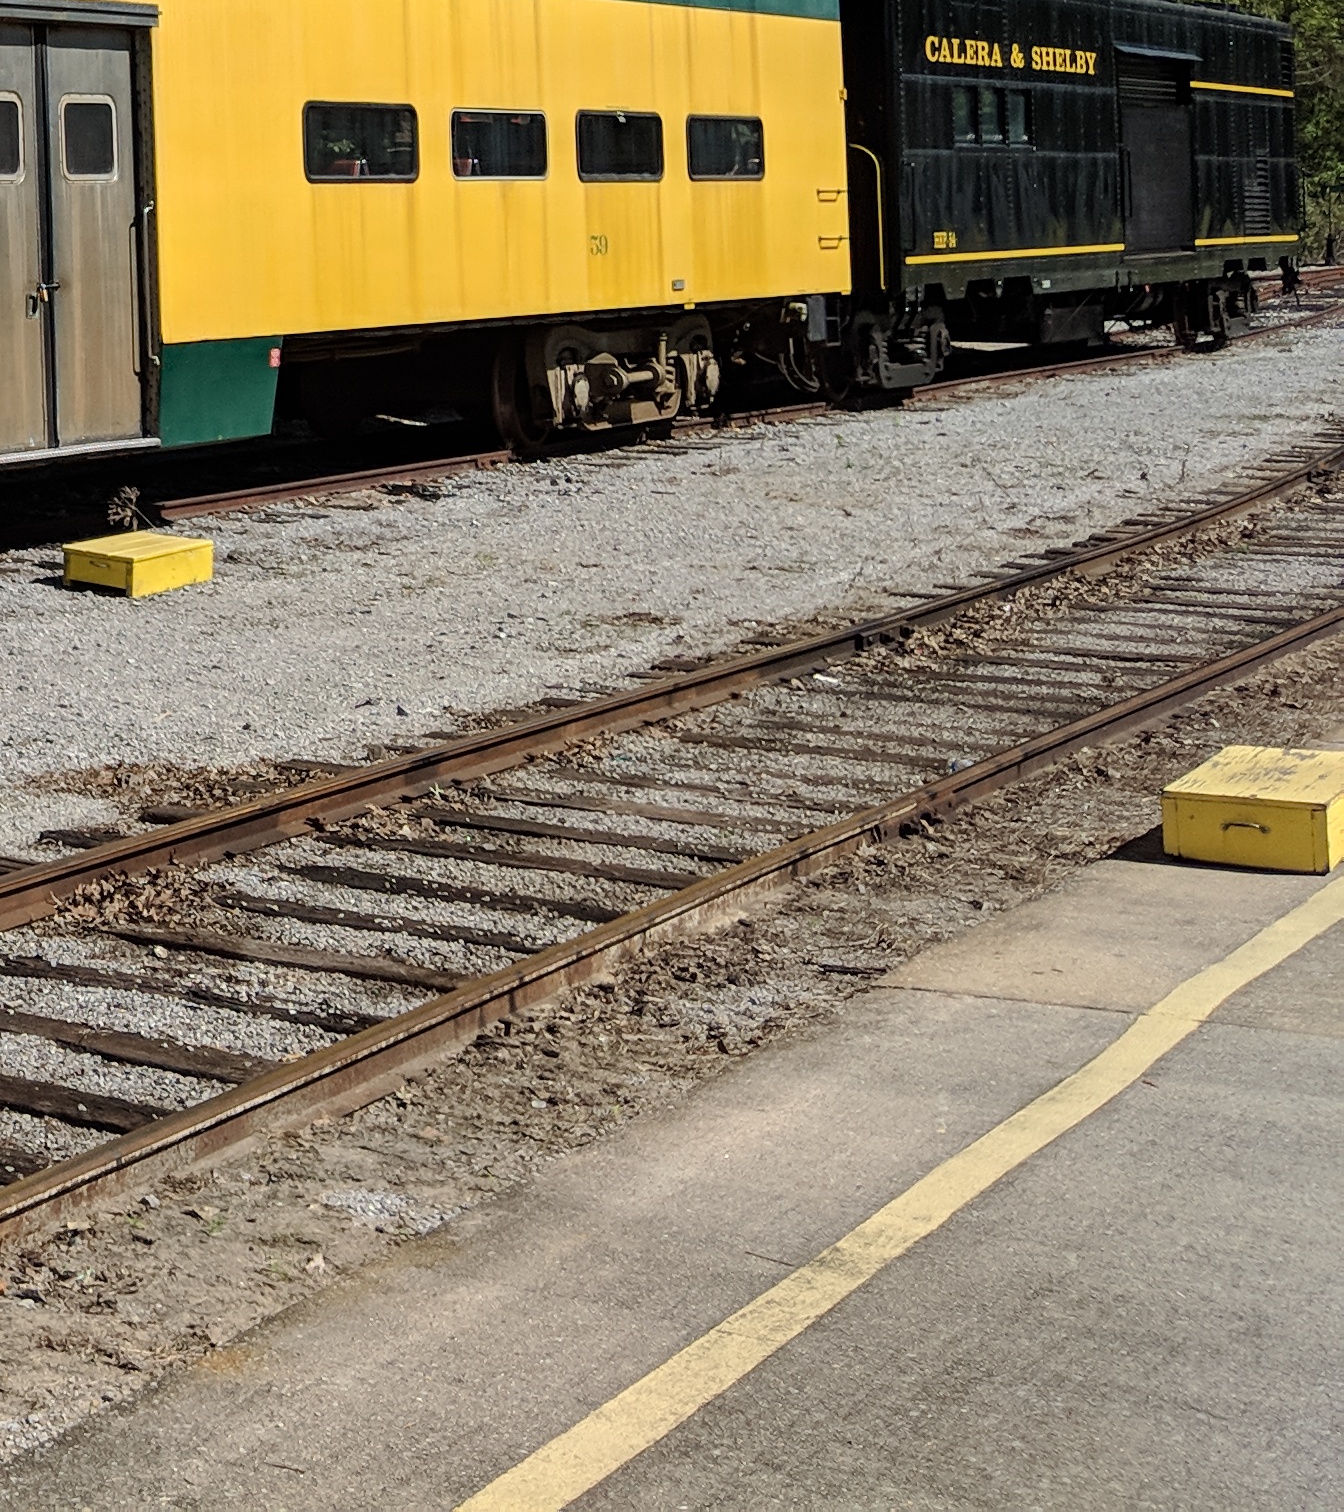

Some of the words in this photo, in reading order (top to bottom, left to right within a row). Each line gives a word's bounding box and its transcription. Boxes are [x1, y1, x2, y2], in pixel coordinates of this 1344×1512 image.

[925, 35, 1003, 68] CALERA
[1010, 43, 1025, 69] &
[1031, 45, 1097, 76] SHELBY
[590, 234, 608, 256] 59
